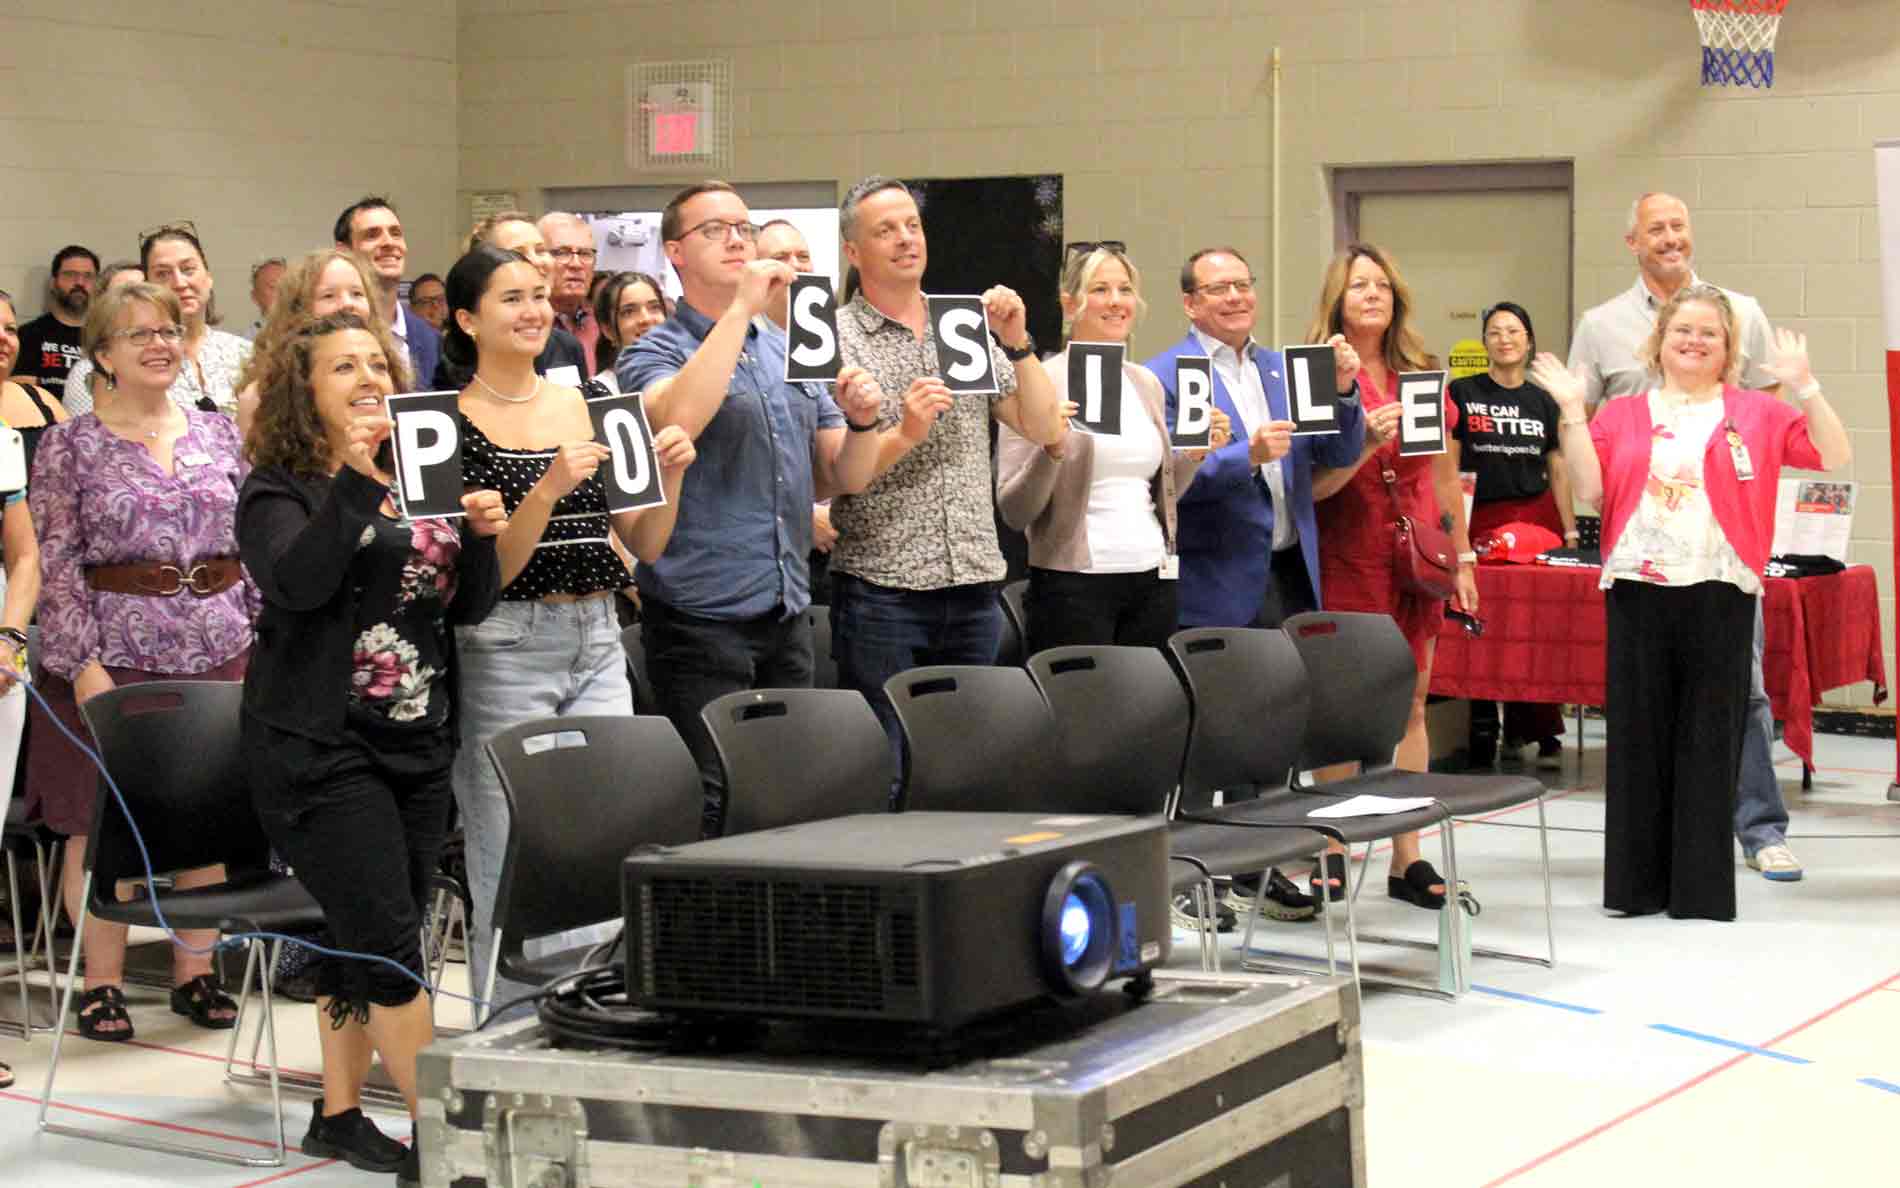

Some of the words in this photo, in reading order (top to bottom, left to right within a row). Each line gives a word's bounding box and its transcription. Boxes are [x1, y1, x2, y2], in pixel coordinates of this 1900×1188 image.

[790, 286, 836, 367] S
[939, 308, 988, 382] S
[1085, 354, 1102, 423] I
[1176, 368, 1211, 435] B
[1293, 357, 1334, 422] L
[1401, 380, 1441, 443] E
[1466, 402, 1488, 415] WE
[1490, 405, 1519, 417] CAN
[397, 410, 457, 502] P
[603, 408, 651, 495] O
[1468, 416, 1545, 438] BETTER
